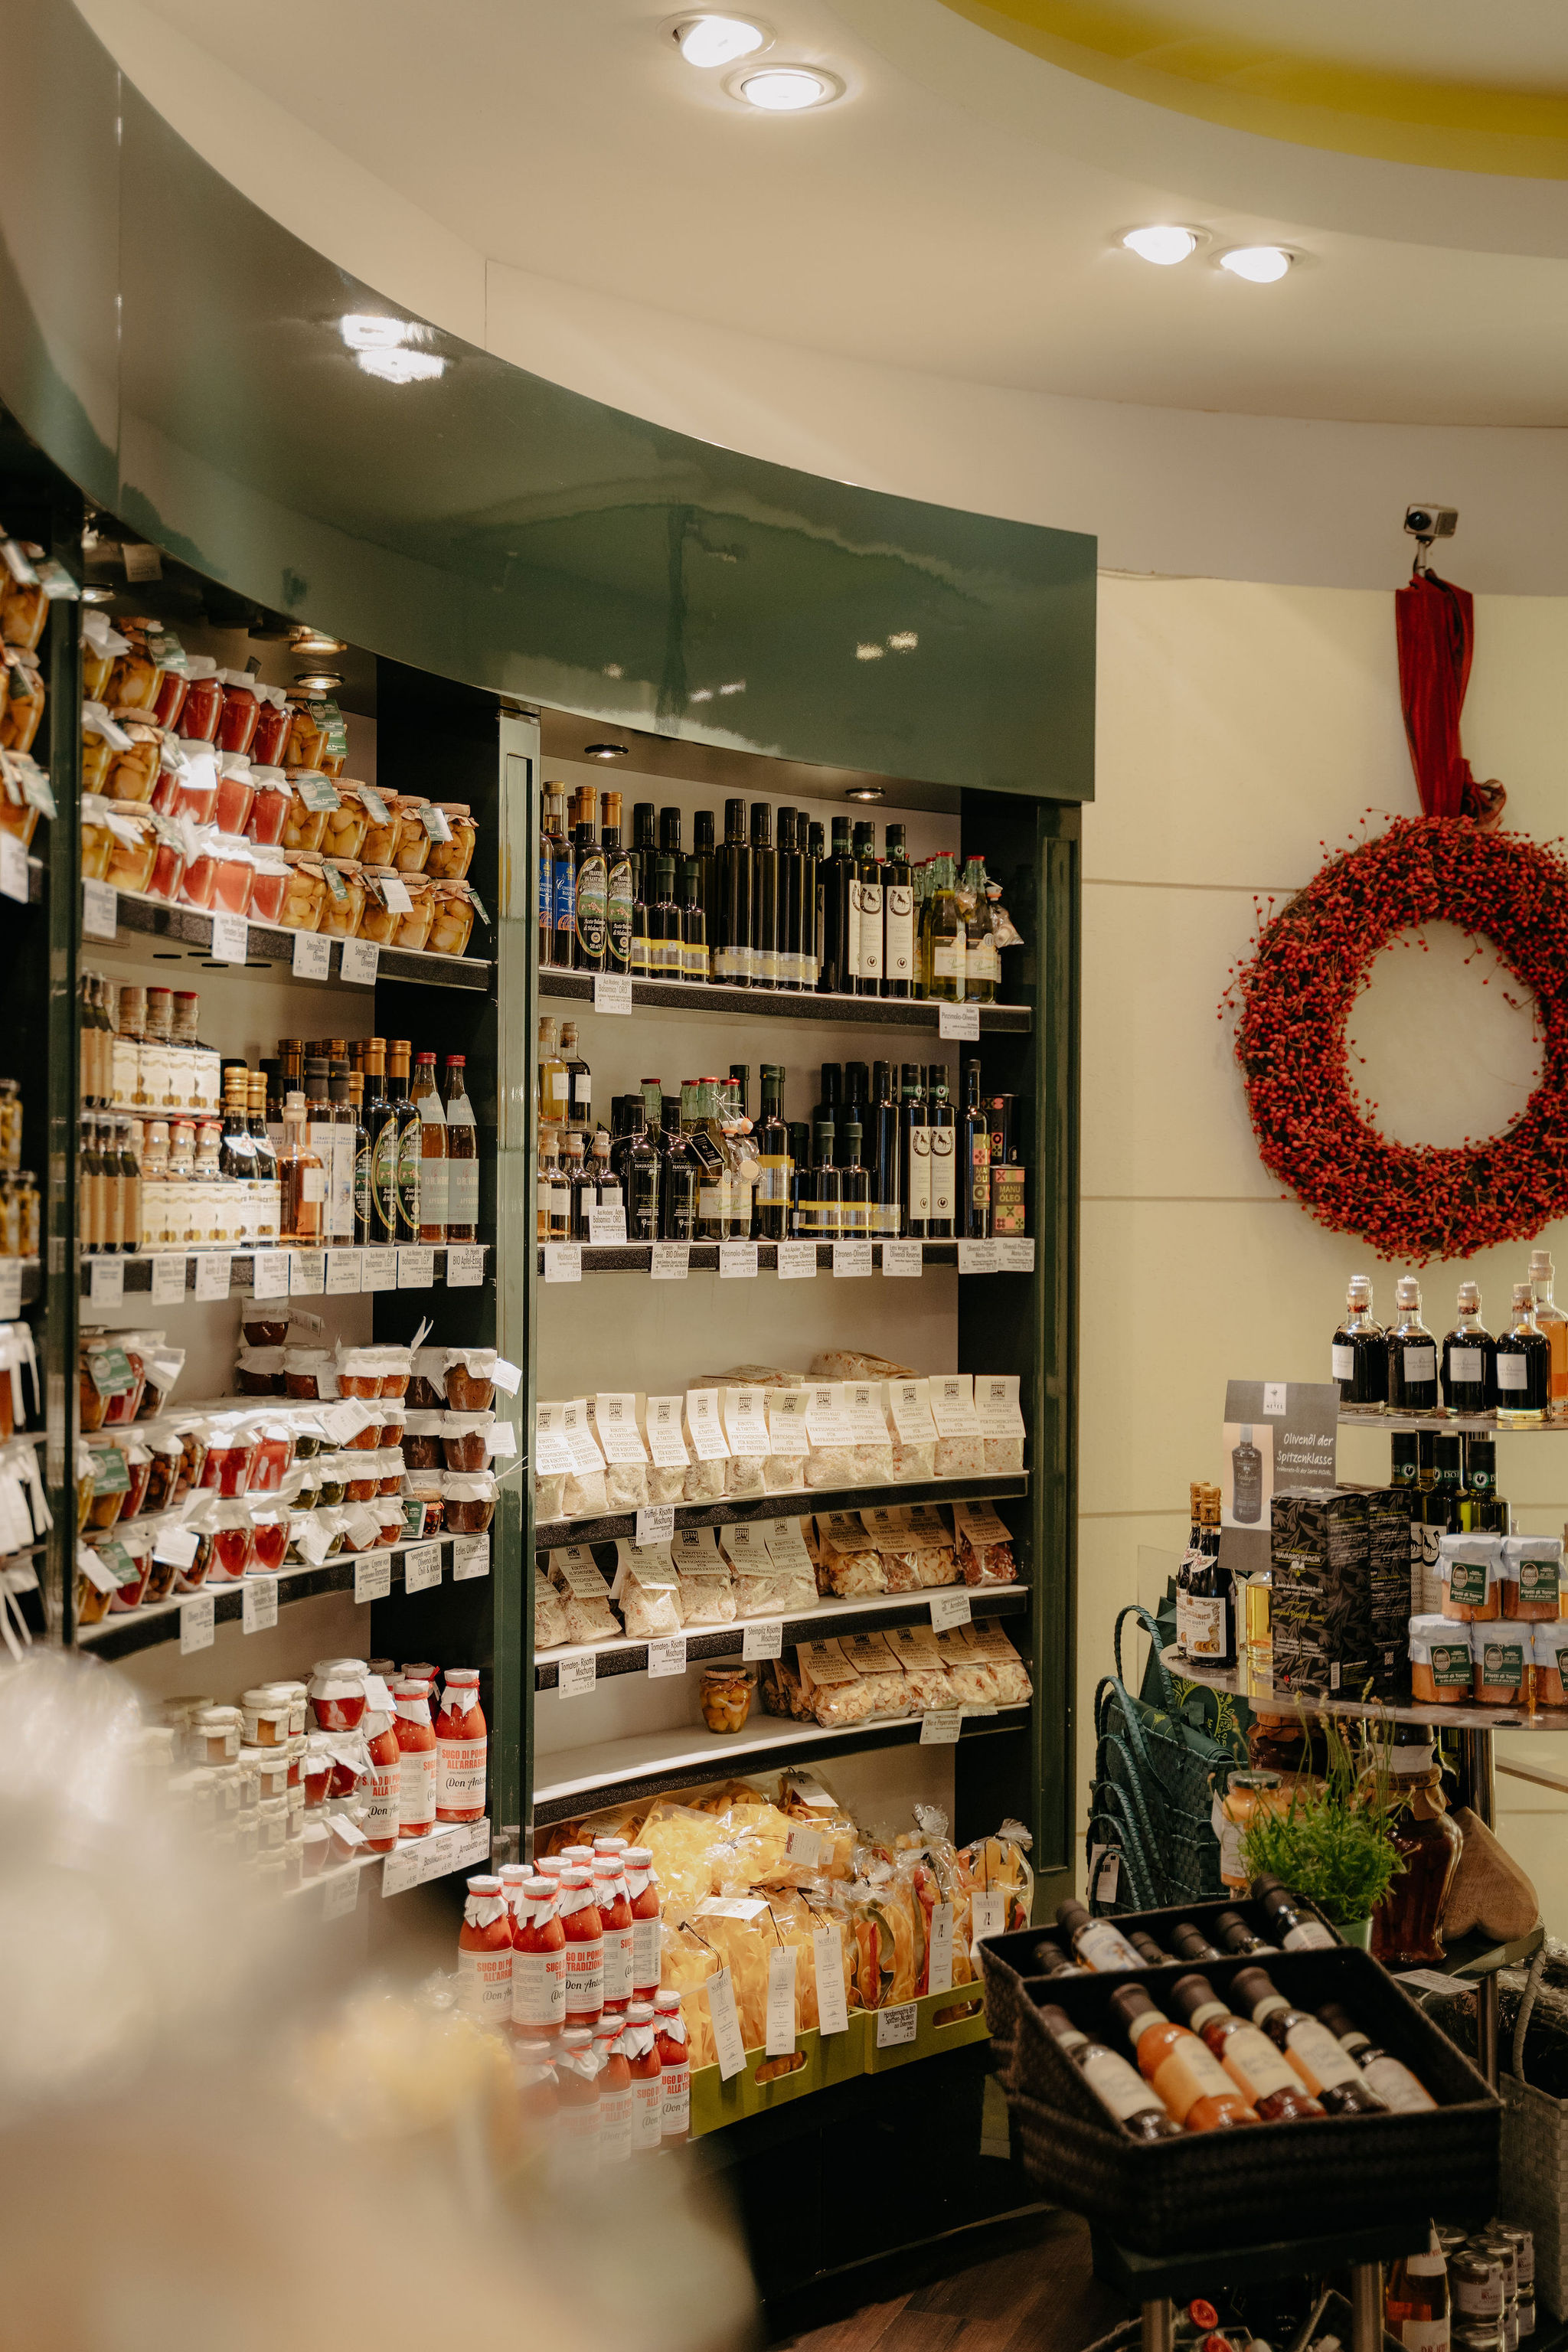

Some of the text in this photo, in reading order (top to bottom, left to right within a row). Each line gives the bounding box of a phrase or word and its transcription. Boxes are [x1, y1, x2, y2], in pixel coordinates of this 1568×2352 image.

[1283, 1432, 1334, 1447] Olivenöl der
[1276, 1449, 1334, 1466] Spitzenklasse
[1276, 1551, 1321, 1564] NAVARRO GARCÍA
[665, 1648, 684, 1658] Mischung
[576, 1666, 594, 1677] Mischung
[442, 1749, 461, 1760] SUGO
[462, 1748, 469, 1758] DI
[384, 1776, 392, 1785] DI
[446, 1777, 466, 1790] Don
[373, 1784, 389, 1797] ALLA
[367, 1805, 387, 1819] Don
[566, 1952, 577, 1962] GO
[577, 1952, 585, 1962] DI
[477, 1959, 505, 1973] SUGO DI
[566, 1979, 583, 1990] Don
[662, 2073, 683, 2086] UGO DI
[637, 2088, 655, 2099] SUGO
[668, 2082, 682, 2095] ALLA
